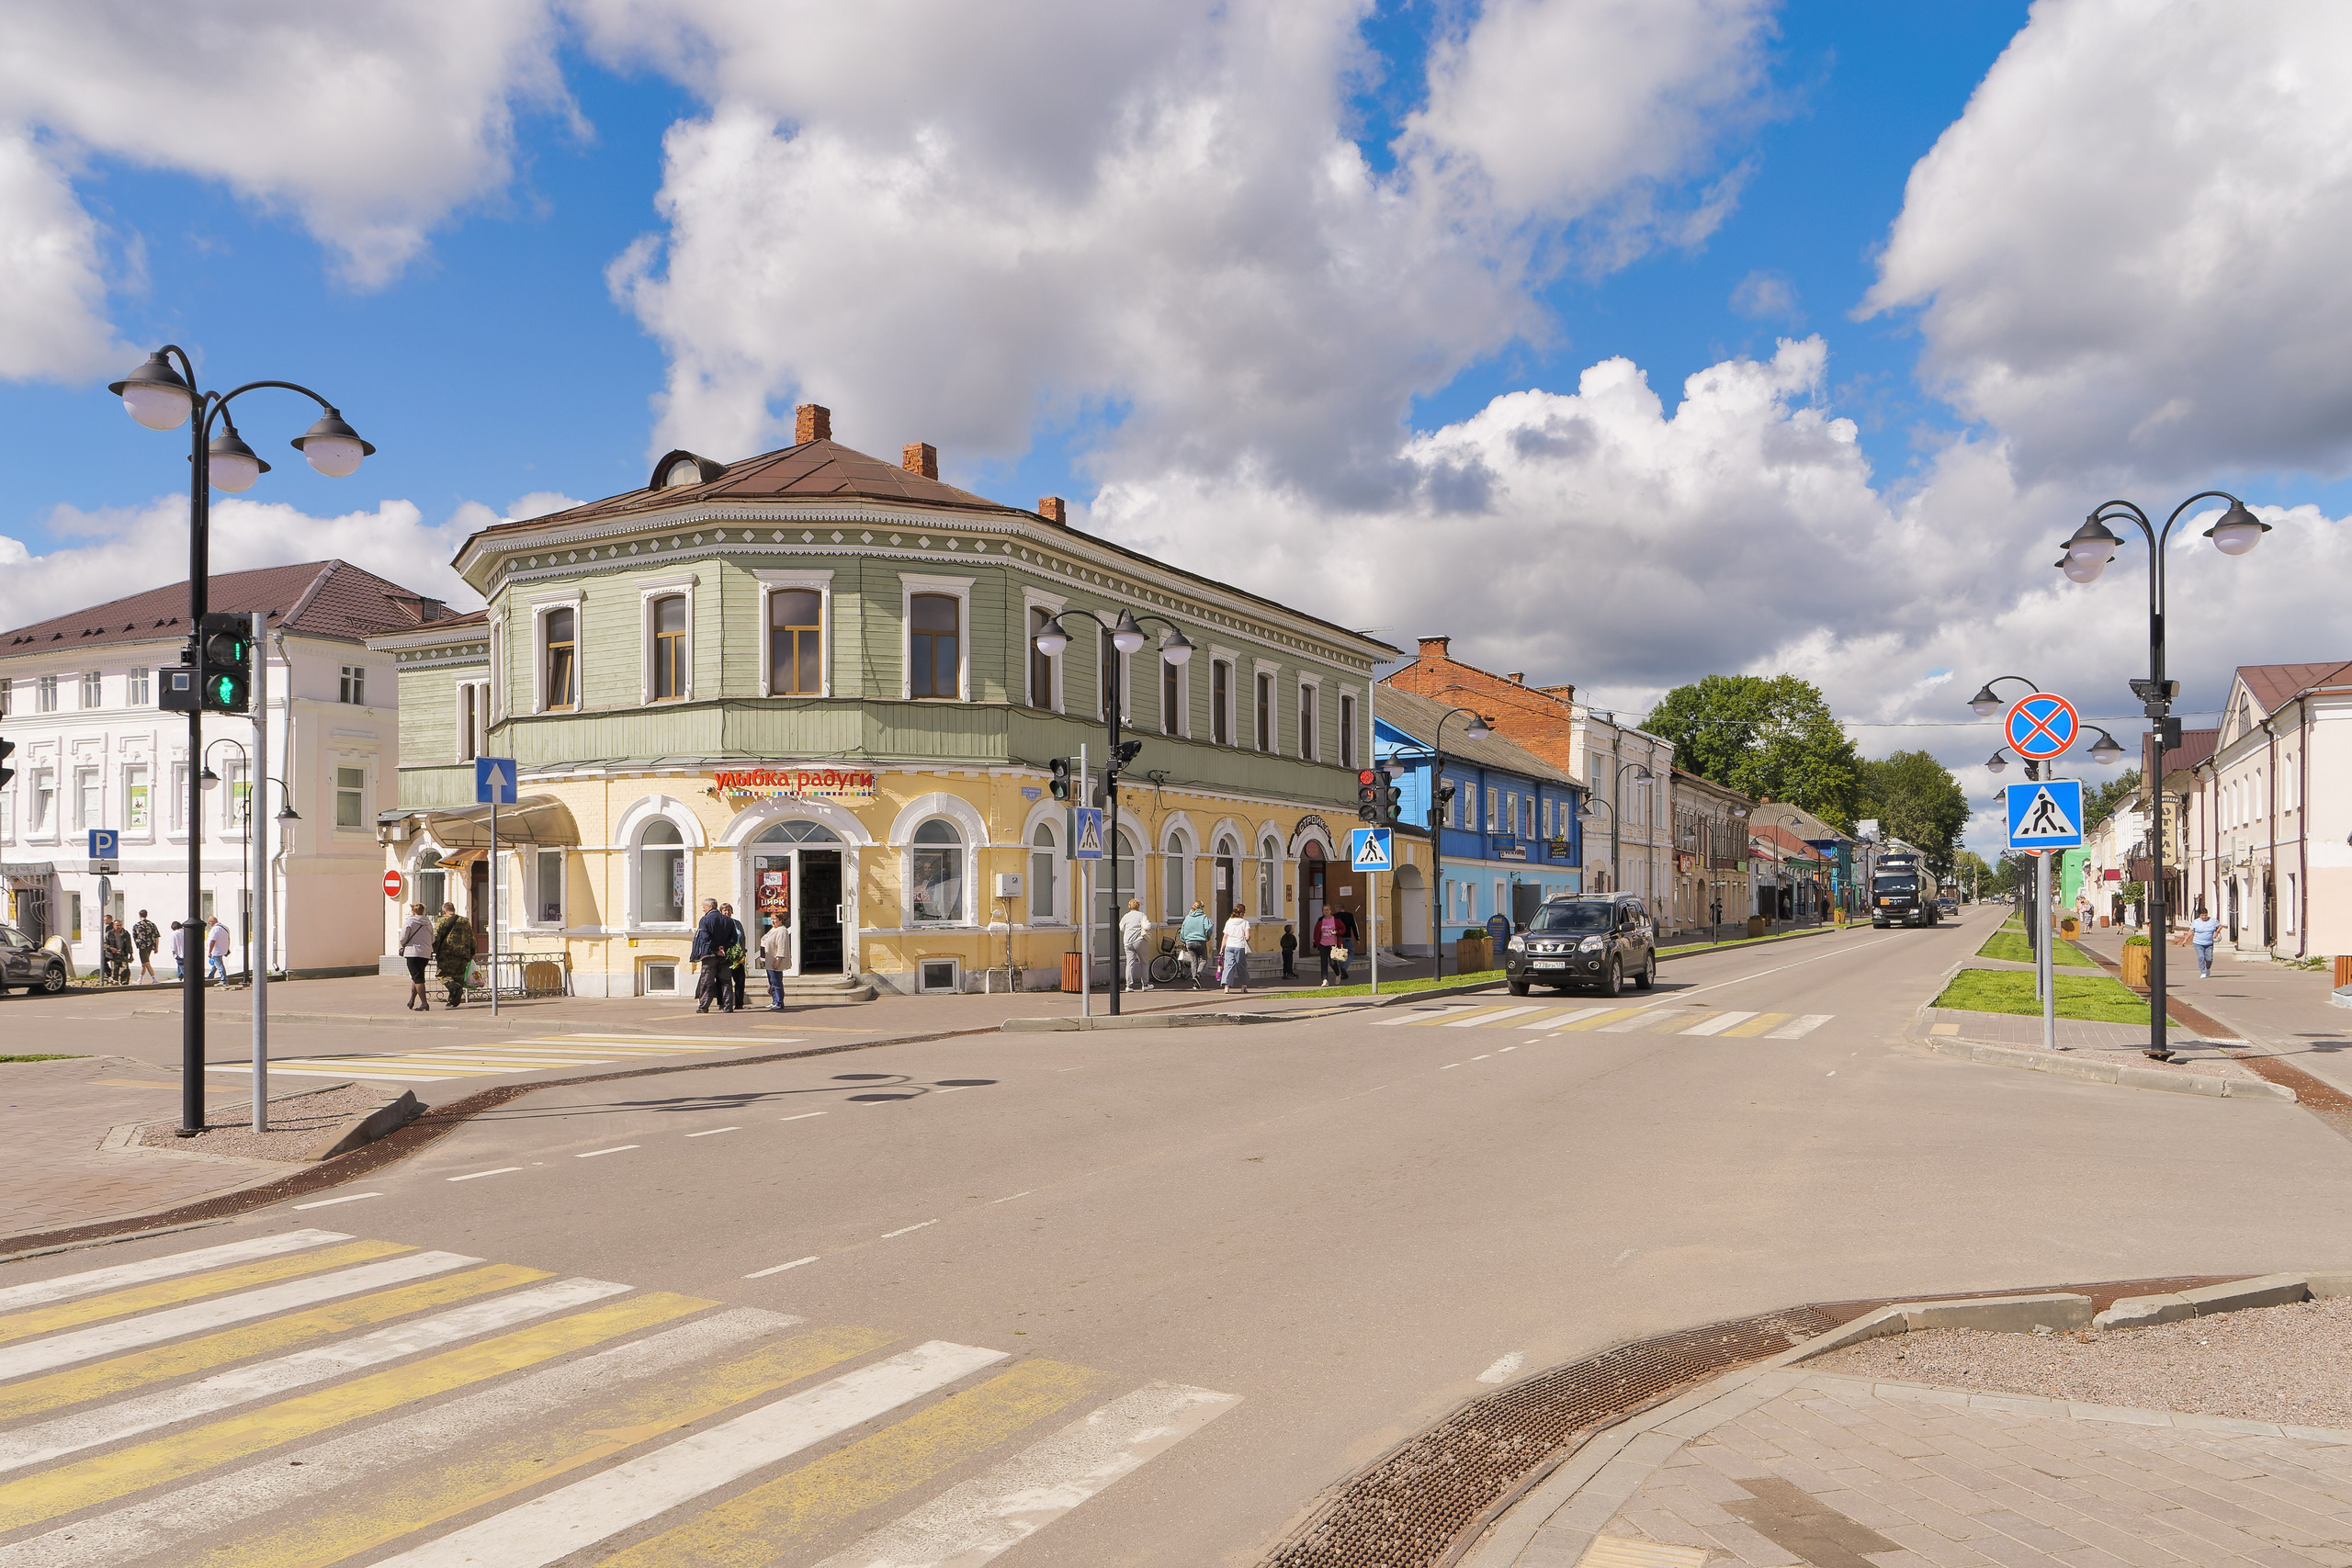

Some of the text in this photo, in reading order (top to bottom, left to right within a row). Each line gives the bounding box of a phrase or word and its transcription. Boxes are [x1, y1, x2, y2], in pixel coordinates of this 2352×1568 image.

[714, 768, 873, 791] улыбка радуги
[1367, 790, 1374, 799] 4
[96, 832, 112, 855] P
[761, 898, 786, 907] ЦИРК
